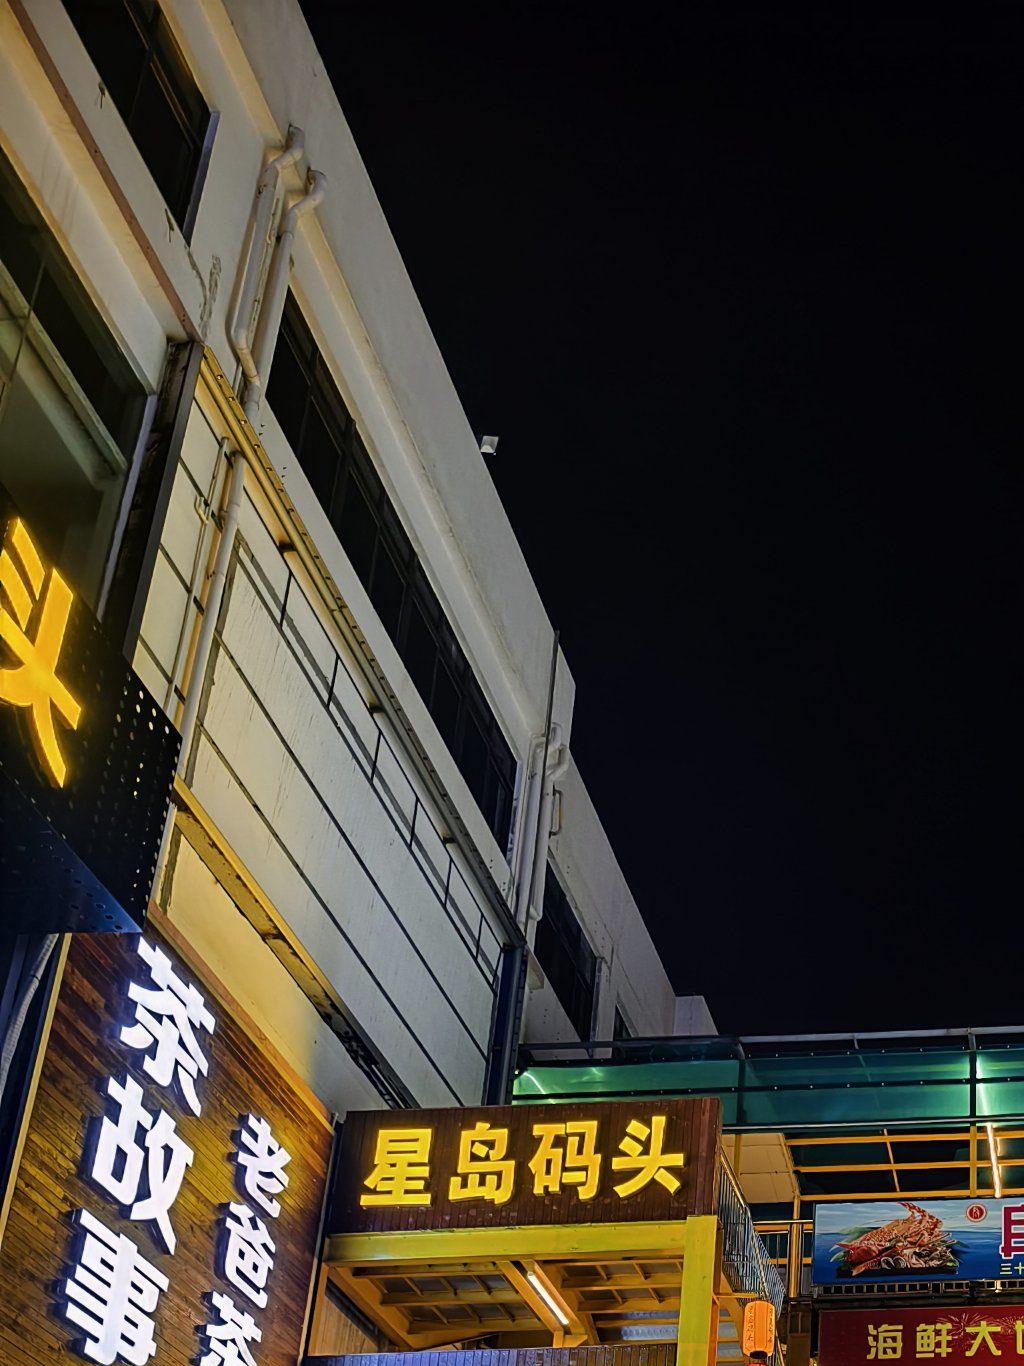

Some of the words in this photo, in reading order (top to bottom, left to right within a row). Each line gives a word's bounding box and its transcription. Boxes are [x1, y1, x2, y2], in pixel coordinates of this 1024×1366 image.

[66, 936, 215, 1366] 茶故事
[360, 1115, 685, 1208] 星岛码头
